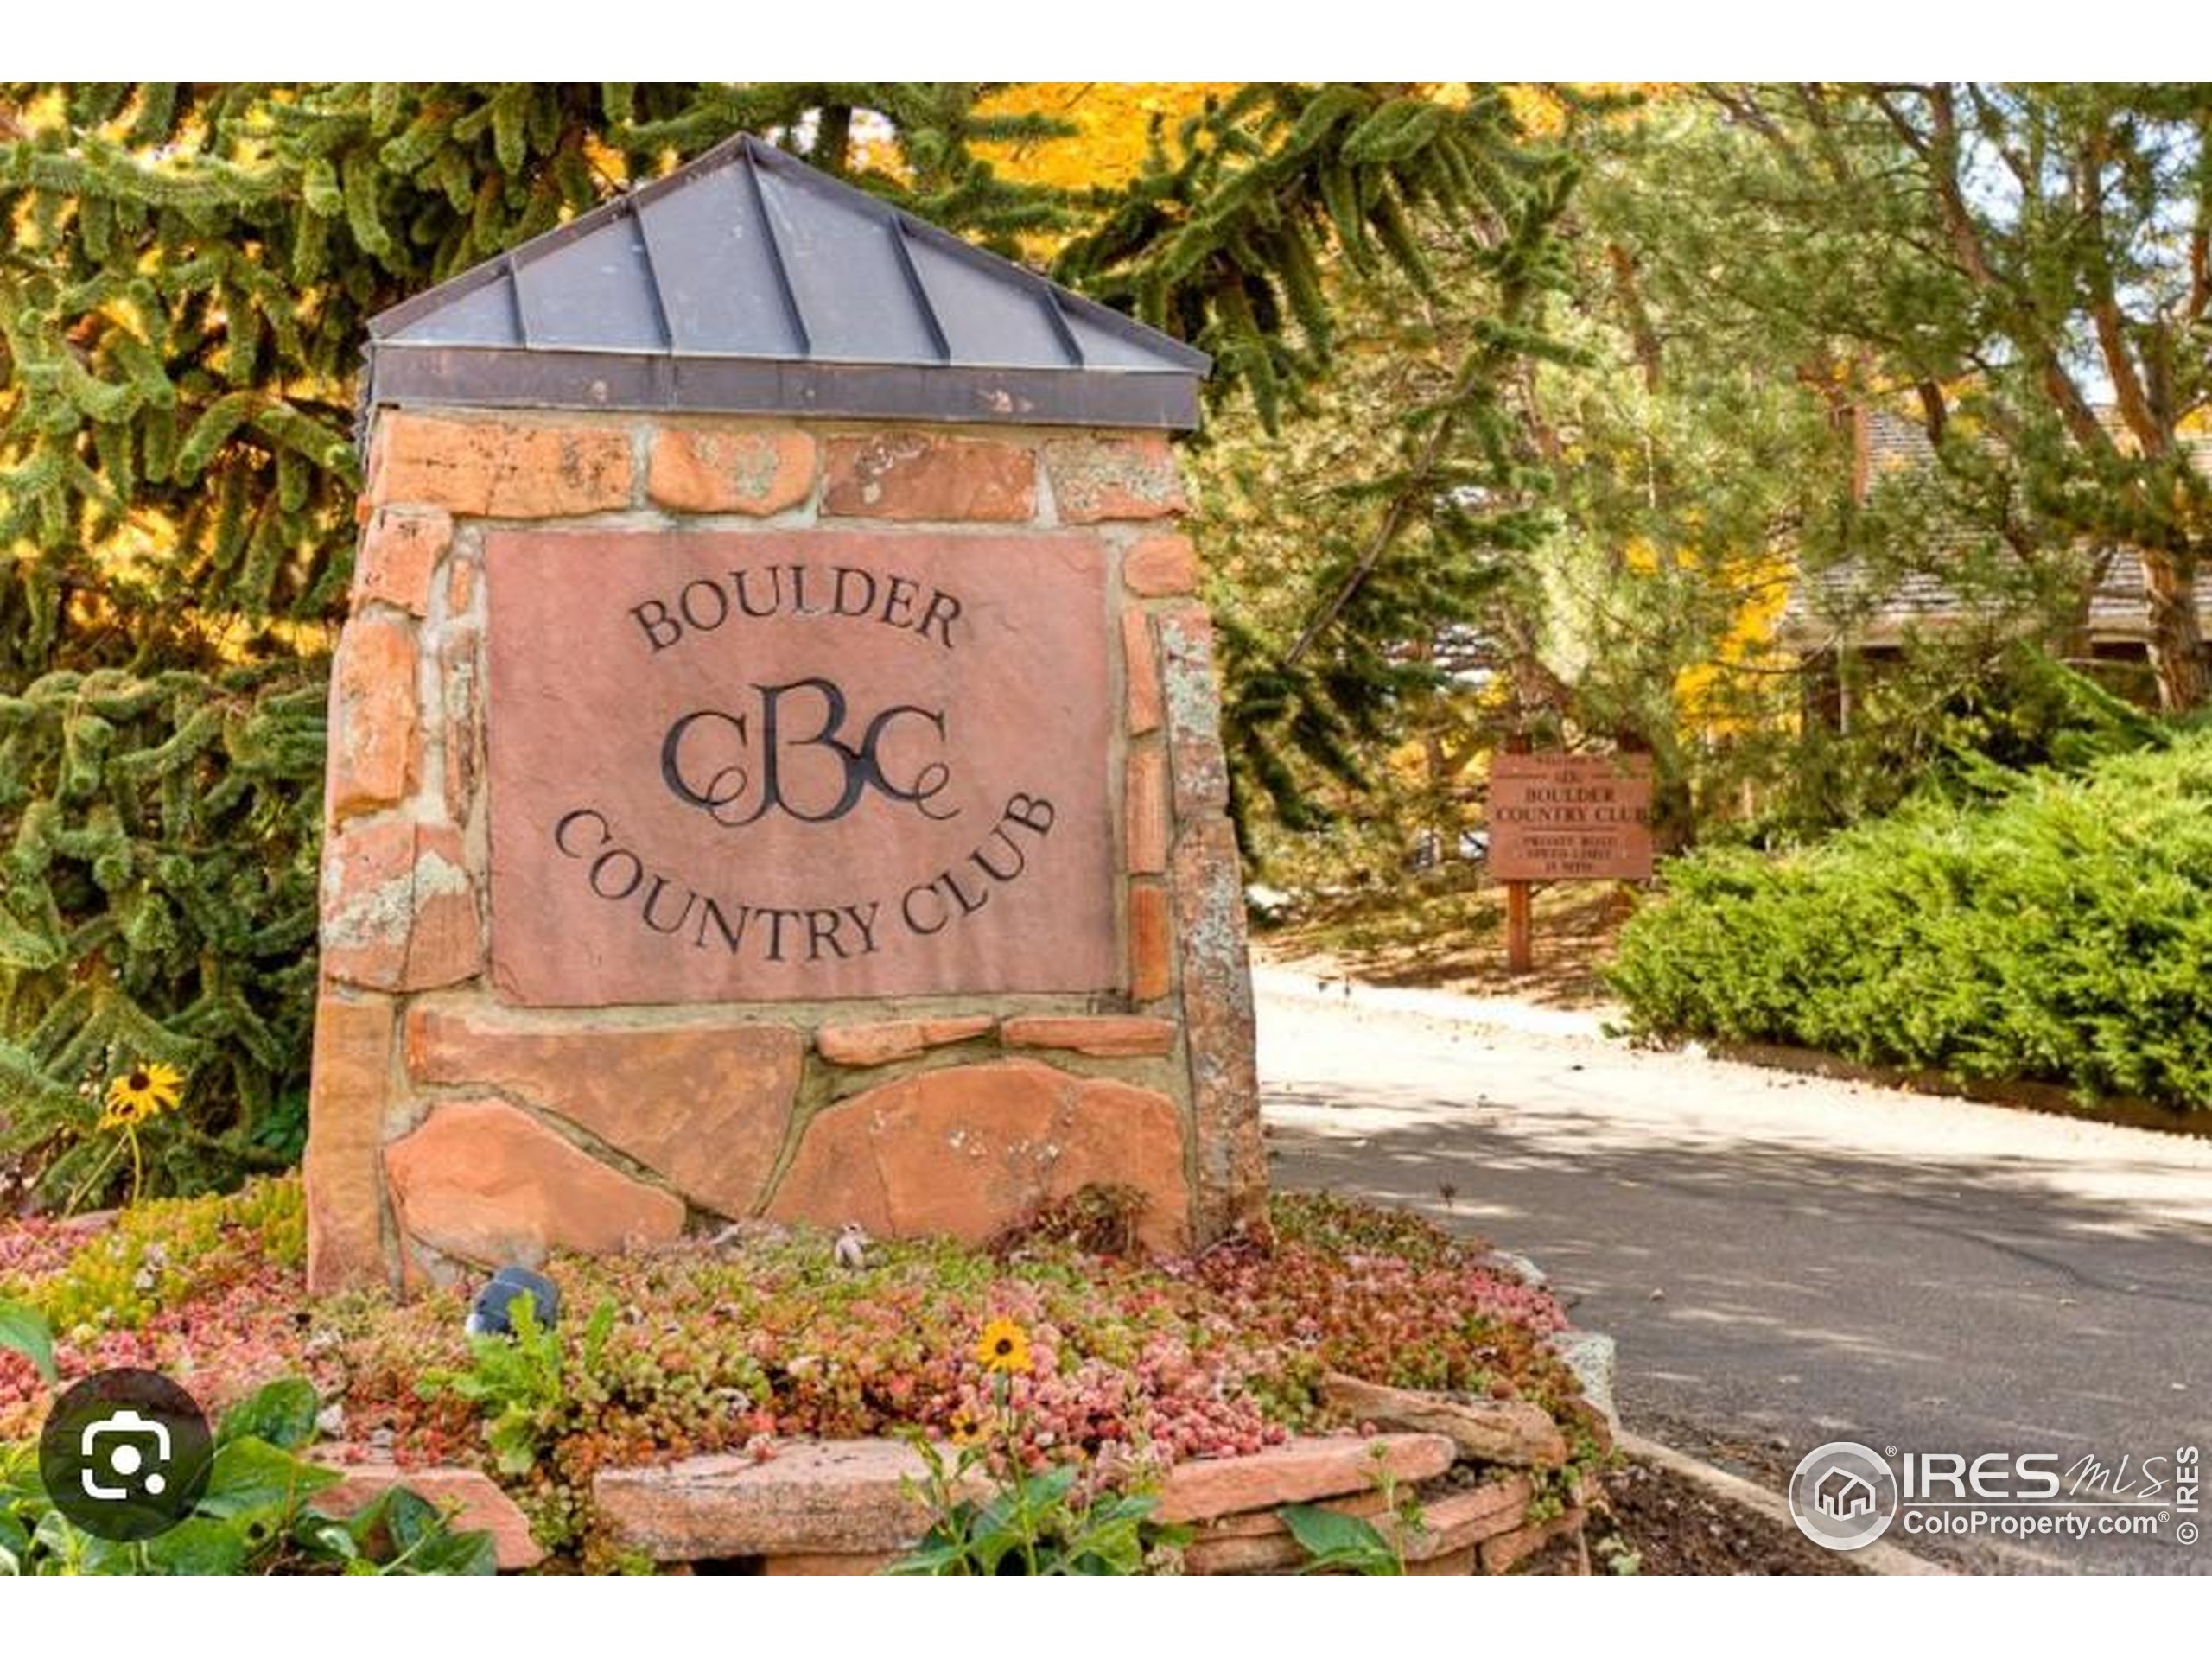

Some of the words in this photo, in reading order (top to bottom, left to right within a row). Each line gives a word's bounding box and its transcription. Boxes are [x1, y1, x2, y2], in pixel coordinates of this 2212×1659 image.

[629, 565, 963, 652] BOULDER
[661, 677, 961, 827] CBC
[1525, 787, 1614, 803] BOULDER
[1496, 807, 1586, 822] COUNTRY
[555, 809, 880, 962] COUNTRY
[902, 791, 1056, 936] CLUB
